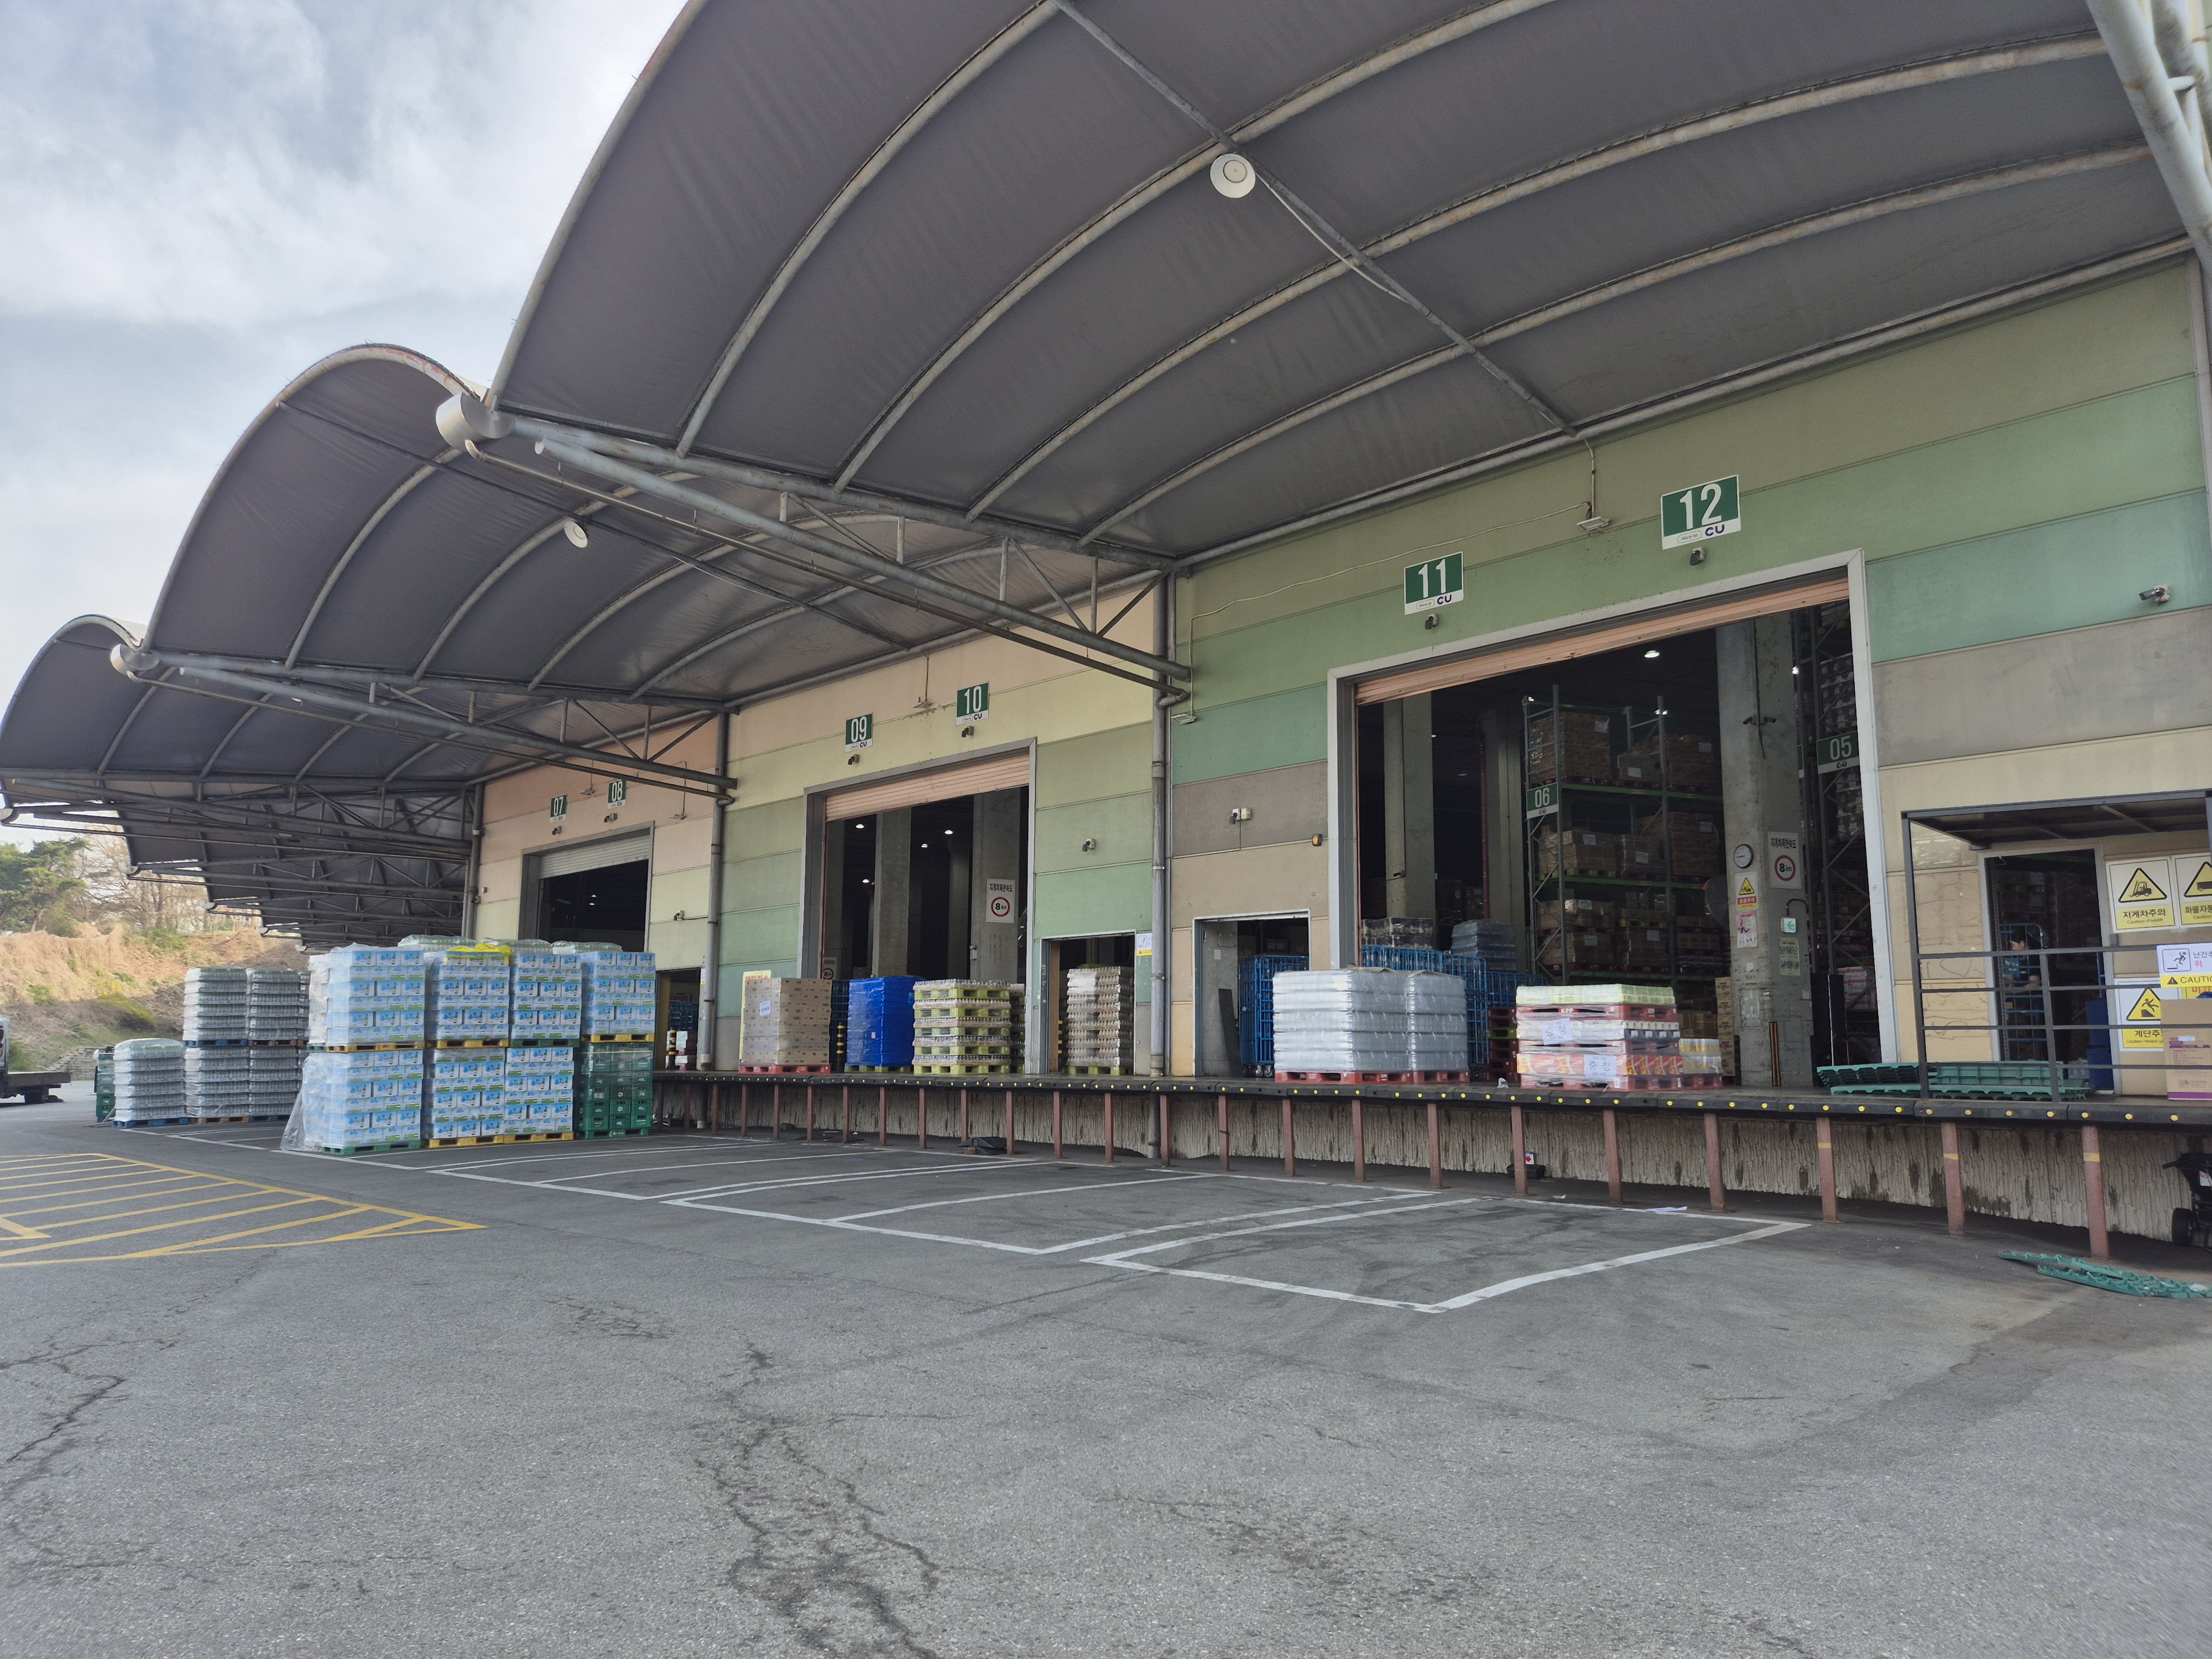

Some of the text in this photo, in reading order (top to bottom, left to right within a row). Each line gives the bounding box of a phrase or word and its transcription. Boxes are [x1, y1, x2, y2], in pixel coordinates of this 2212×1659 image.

[1679, 483, 1722, 530] 12
[1705, 524, 1725, 537] CU
[1418, 559, 1446, 598] 11
[1437, 594, 1452, 605] CU
[964, 685, 982, 714] 10
[851, 716, 867, 743] 09
[1830, 735, 1851, 760] 05
[612, 780, 623, 802] 08
[1535, 787, 1550, 808] 06
[554, 796, 564, 816] 07
[2122, 908, 2166, 919] 지게차주의
[2135, 1030, 2163, 1038] 계단주
